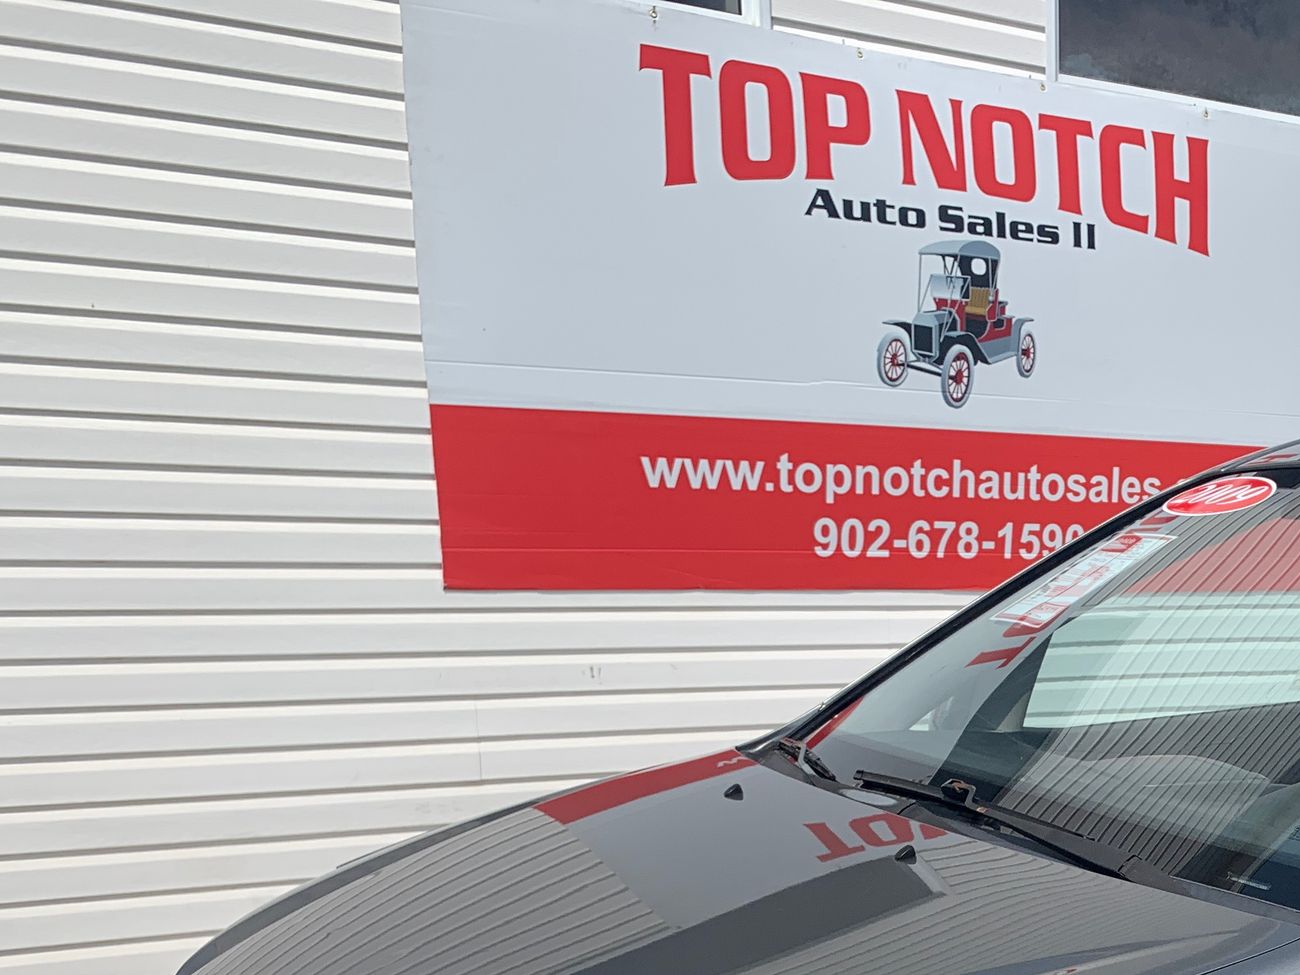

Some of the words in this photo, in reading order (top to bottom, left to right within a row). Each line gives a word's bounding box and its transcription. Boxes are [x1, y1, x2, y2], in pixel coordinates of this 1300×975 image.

[639, 44, 872, 187] TOP
[895, 89, 1211, 257] NOTCH
[804, 188, 926, 229] Auto
[938, 204, 1060, 245] Sales
[1072, 221, 1096, 250] II
[640, 453, 1187, 505] www.topnotchautosales
[1170, 482, 1269, 506] 2009
